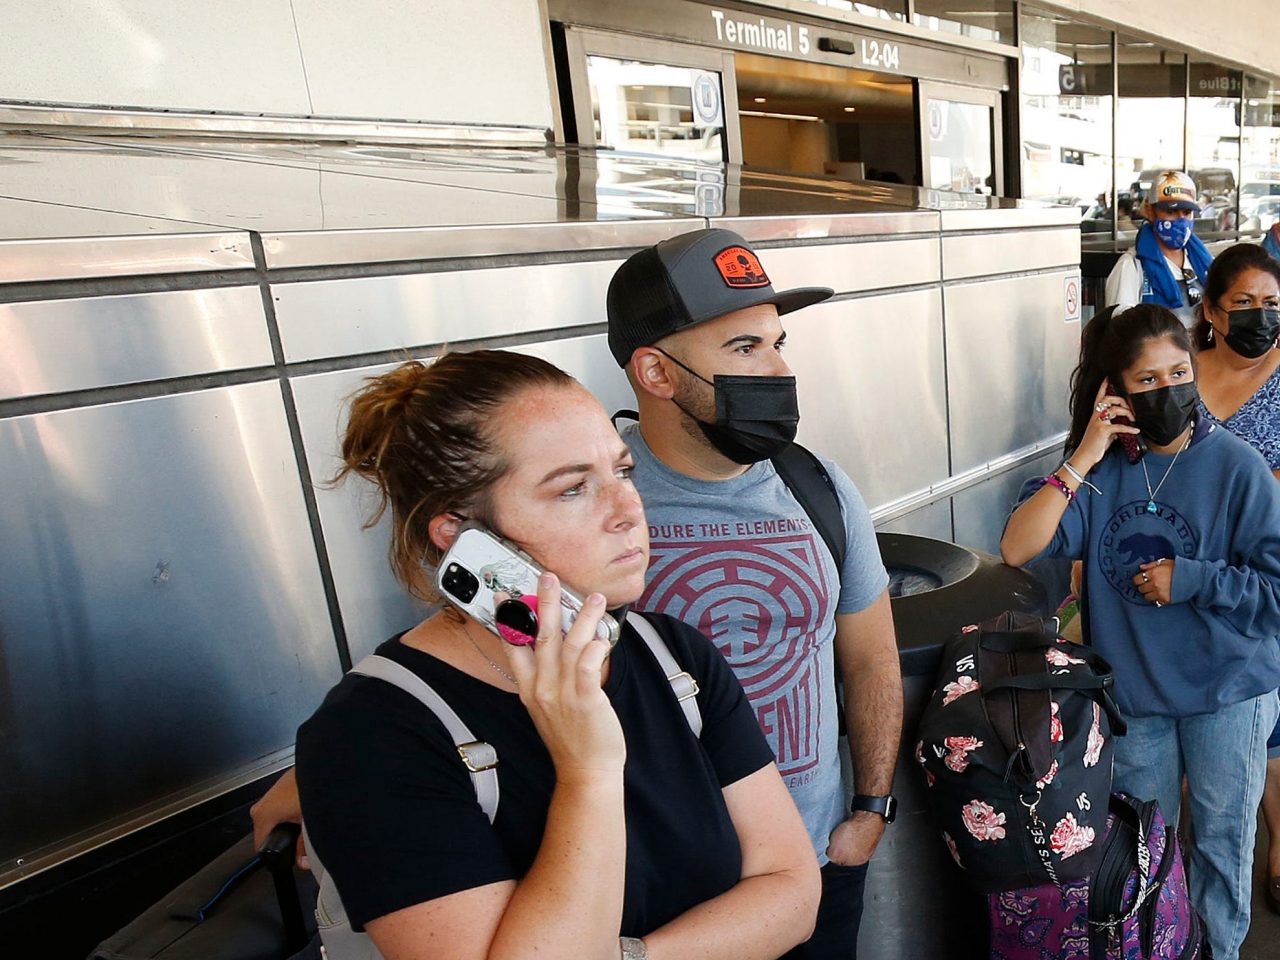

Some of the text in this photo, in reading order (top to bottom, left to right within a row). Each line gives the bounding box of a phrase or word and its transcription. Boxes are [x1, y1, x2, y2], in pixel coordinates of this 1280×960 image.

[711, 10, 810, 54] Terminal 5
[861, 39, 900, 69] L2-04
[699, 522, 729, 537] THE
